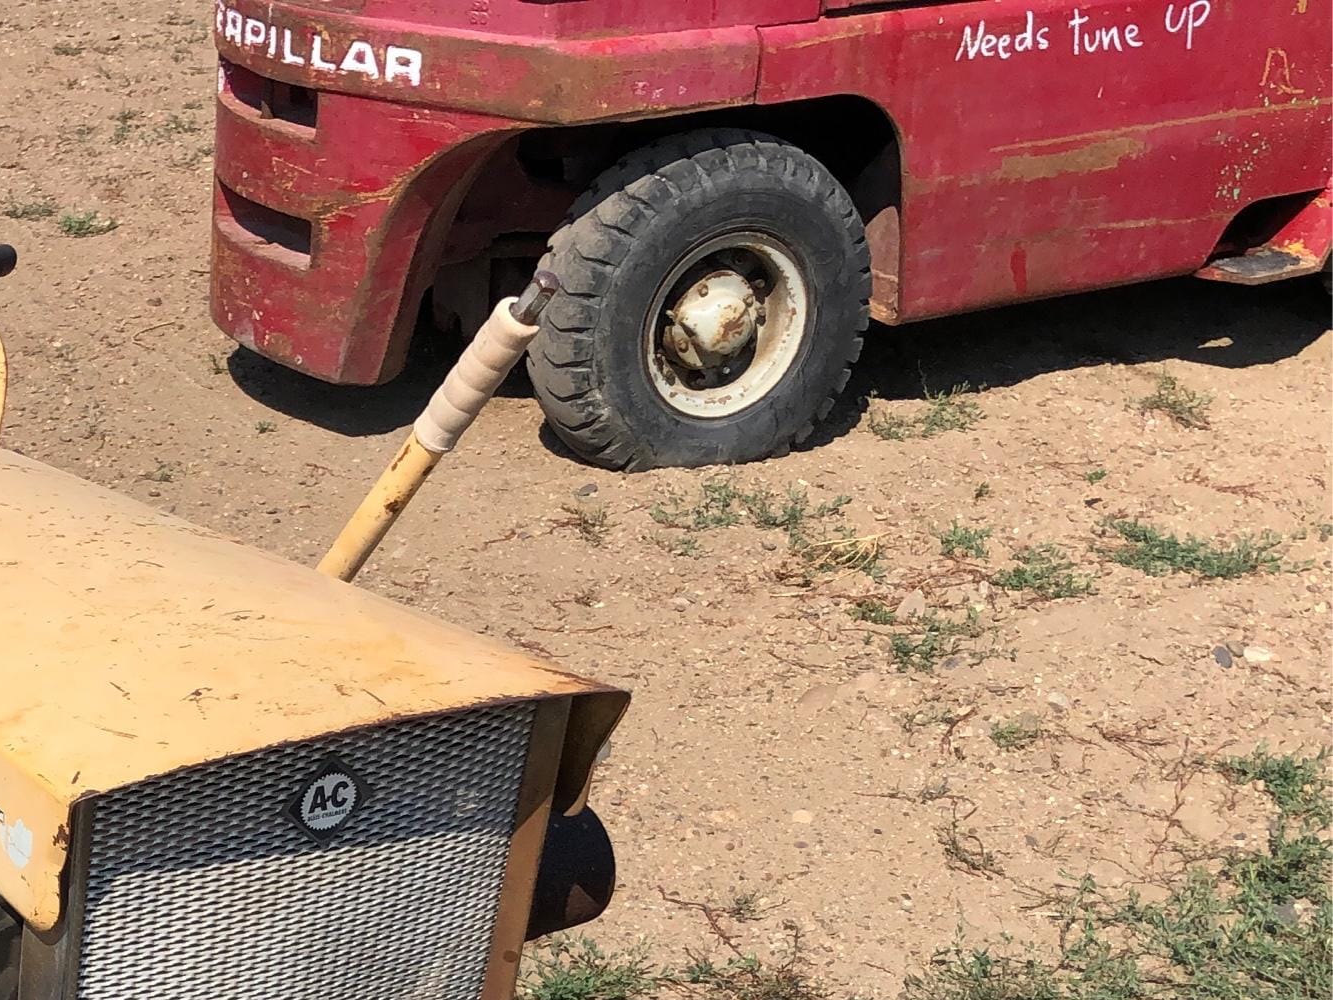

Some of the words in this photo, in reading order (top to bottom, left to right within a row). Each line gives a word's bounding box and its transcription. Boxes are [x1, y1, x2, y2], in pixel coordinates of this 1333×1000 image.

[955, 10, 1050, 62] Needs
[1068, 8, 1144, 55] tune
[308, 780, 350, 814] A-C
